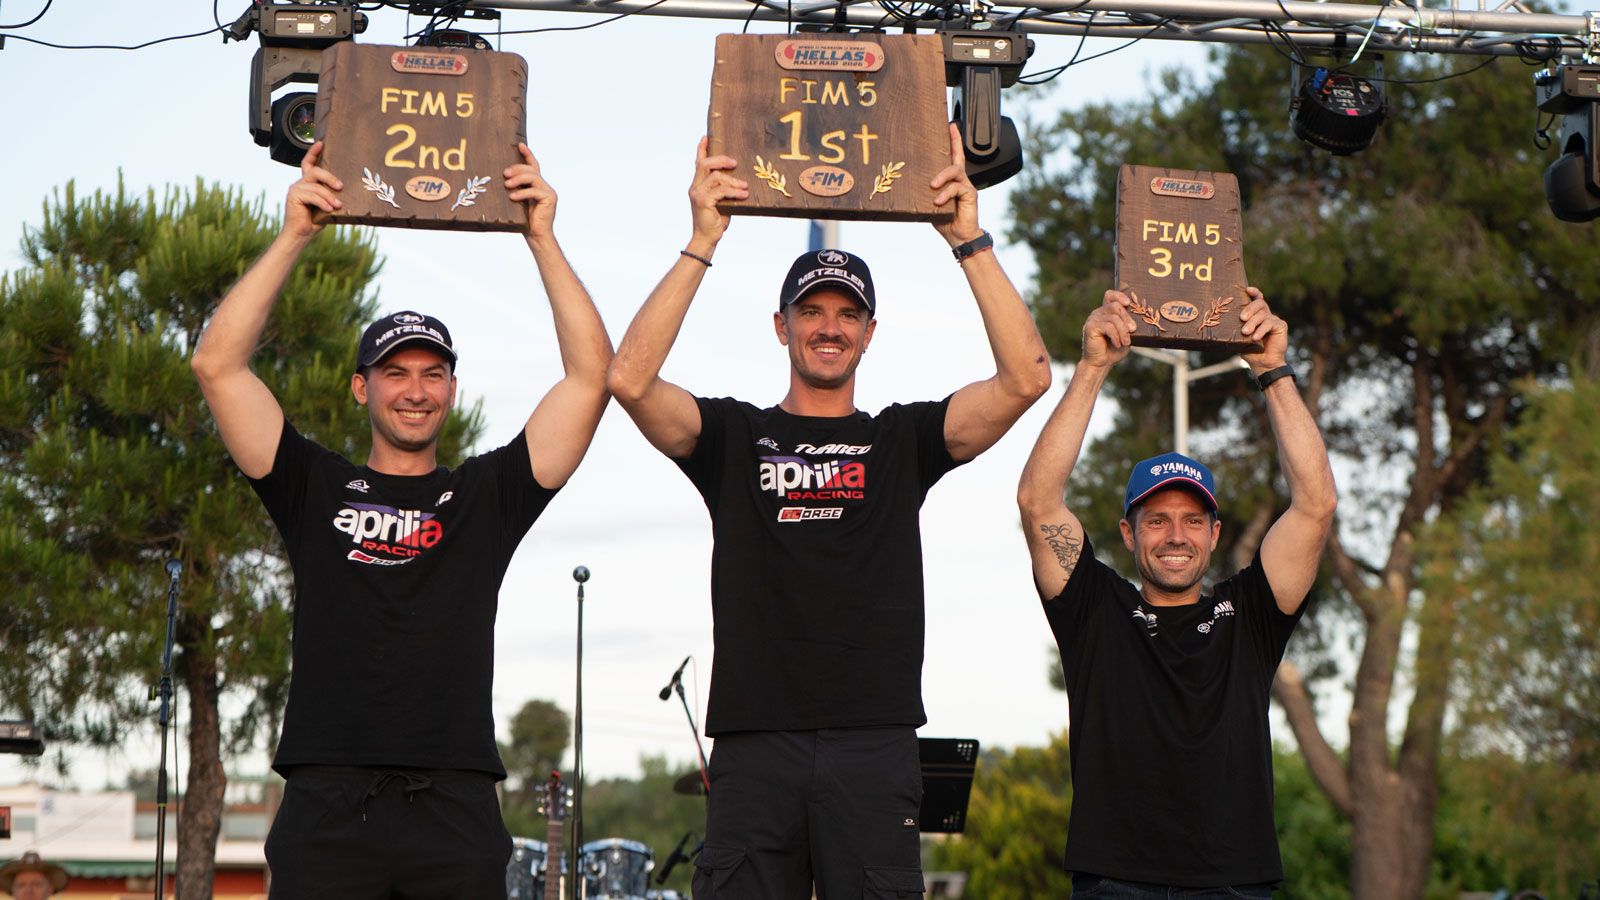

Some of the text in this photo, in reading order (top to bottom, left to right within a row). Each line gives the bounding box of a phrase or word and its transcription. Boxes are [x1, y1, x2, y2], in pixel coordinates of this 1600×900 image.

[404, 57, 455, 67] HELLAS
[795, 50, 864, 61] HELLAS
[380, 88, 474, 118] FIM 5
[780, 77, 878, 107] FIM 5
[384, 124, 467, 171] 2nd
[778, 110, 879, 165] 1st
[414, 181, 444, 194] FIM
[811, 172, 846, 187] FIM
[1161, 182, 1203, 191] HELLAS
[1142, 220, 1220, 246] FIM 5
[1148, 247, 1213, 282] 3rd
[798, 267, 865, 292] METZELER
[1168, 306, 1194, 316] FIM
[376, 324, 444, 346] METZELER
[760, 460, 865, 496] aprilia
[1162, 462, 1202, 480] YAMAHA
[788, 490, 864, 500] RACING
[333, 508, 443, 548] aprilia
